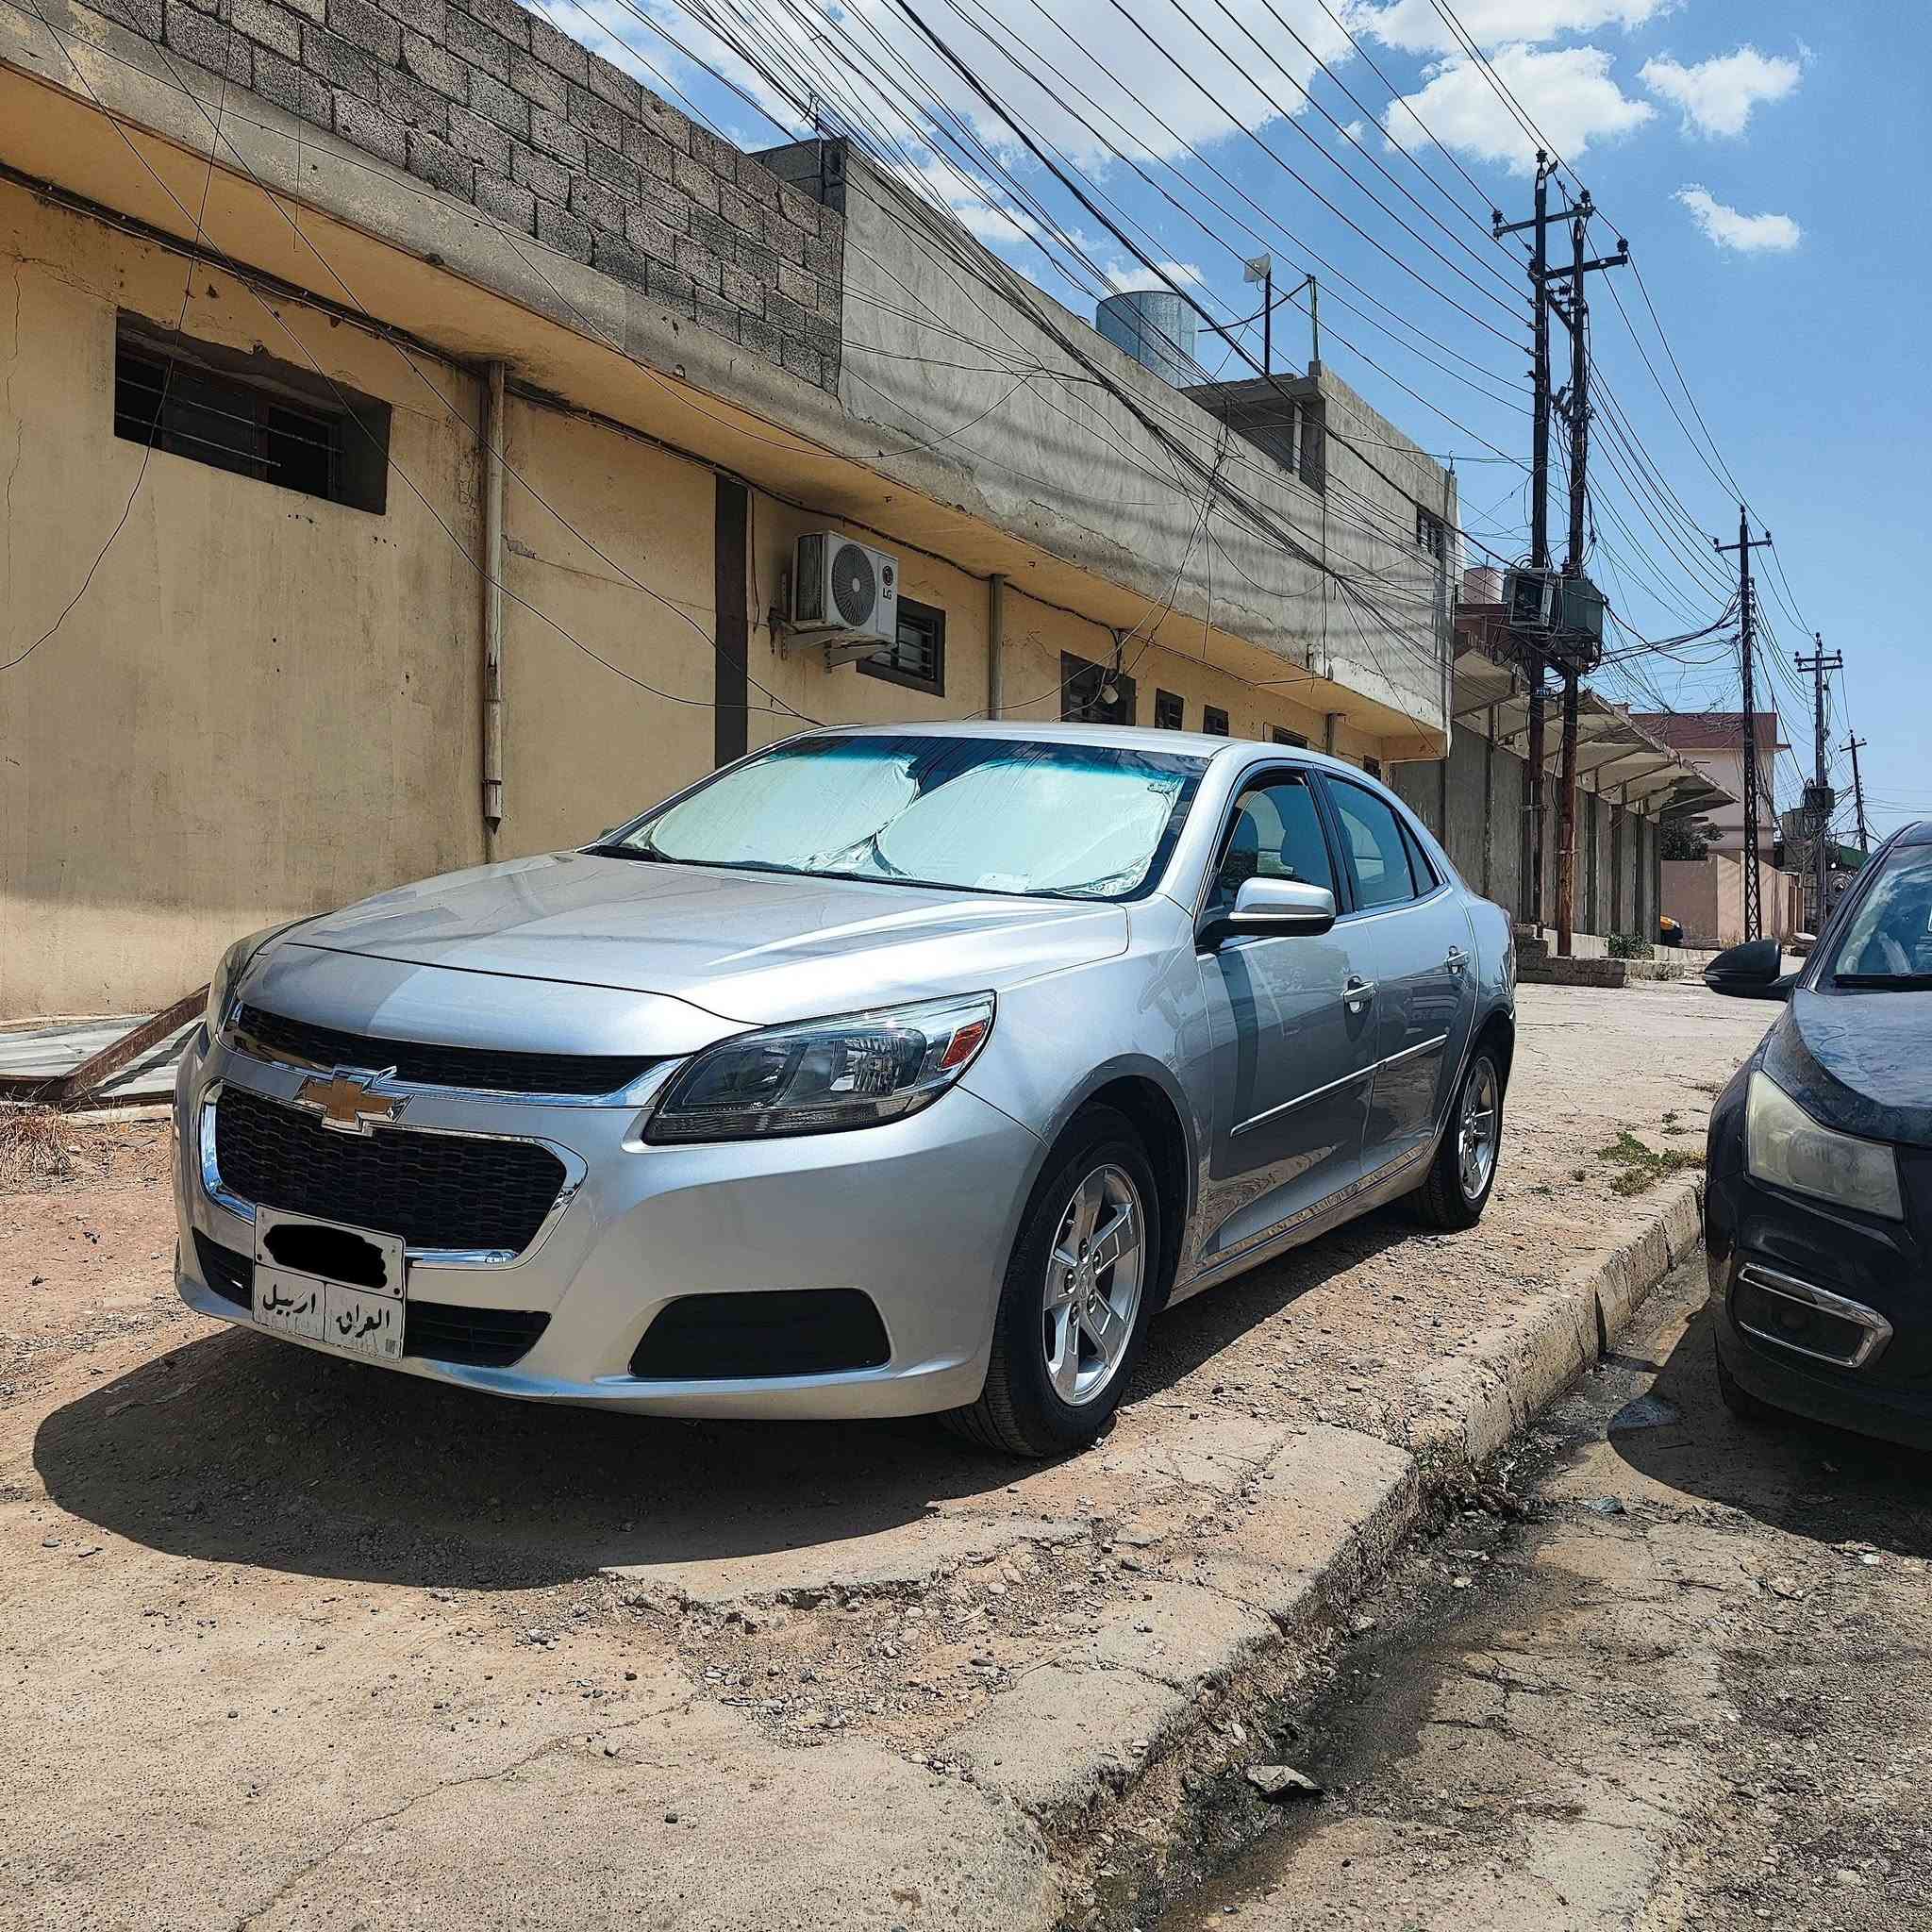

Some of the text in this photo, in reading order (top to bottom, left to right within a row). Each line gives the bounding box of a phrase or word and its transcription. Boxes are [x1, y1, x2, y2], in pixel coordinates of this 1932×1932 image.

[882, 587, 892, 601] LG
[262, 1284, 316, 1318] اربيل
[336, 1303, 391, 1338] العراق
